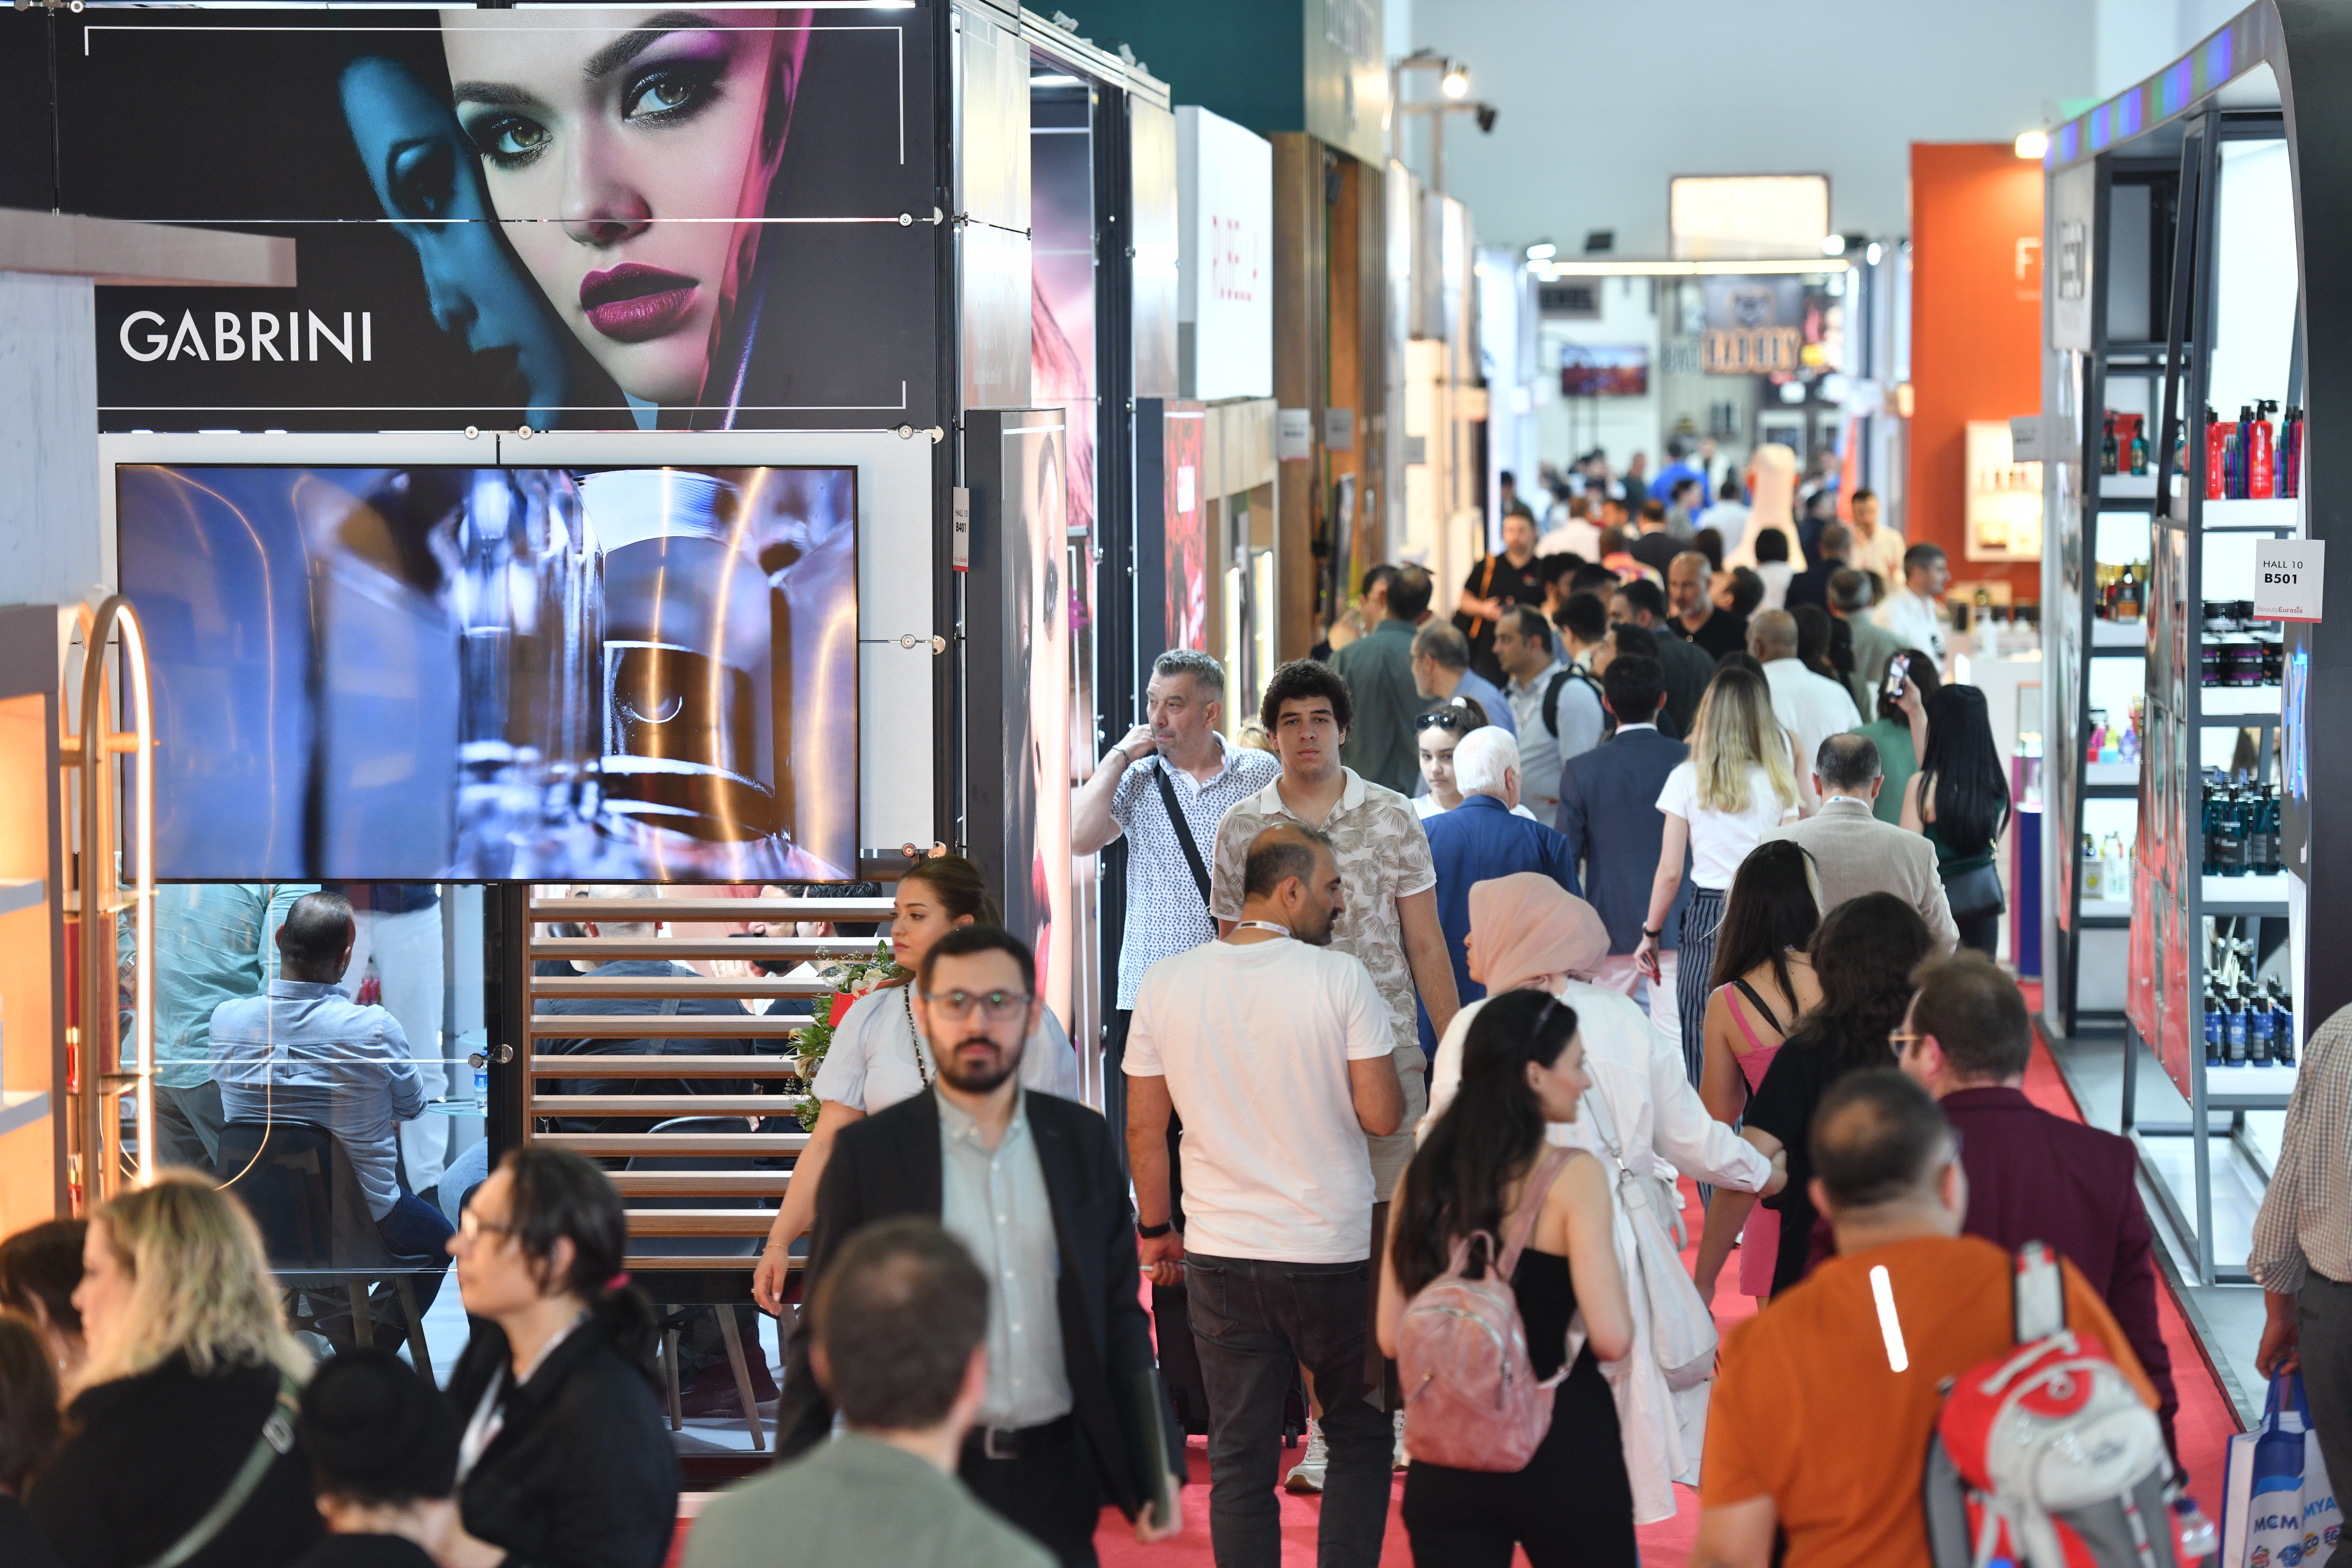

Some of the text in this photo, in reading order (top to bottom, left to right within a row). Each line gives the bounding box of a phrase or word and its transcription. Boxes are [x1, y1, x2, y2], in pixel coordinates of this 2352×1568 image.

[120, 308, 371, 364] GABRINI
[956, 522, 966, 533] B401
[2264, 573, 2297, 584] B501
[2253, 1514, 2299, 1534] MCM
